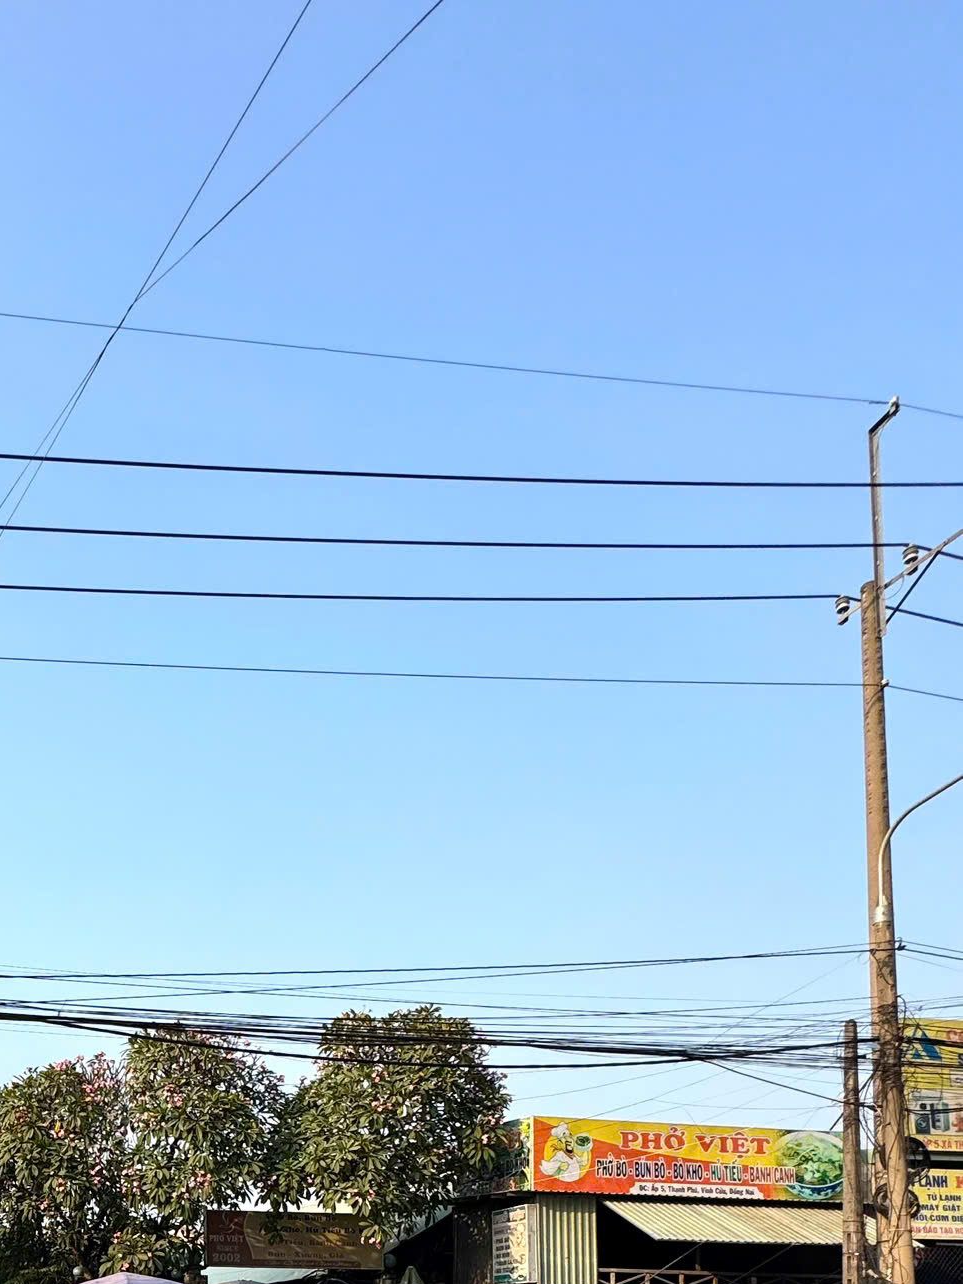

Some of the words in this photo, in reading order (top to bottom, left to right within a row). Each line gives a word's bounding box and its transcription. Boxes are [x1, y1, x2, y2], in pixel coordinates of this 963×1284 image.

[620, 1127, 686, 1151] PHỞ
[695, 1132, 771, 1158] VIỆT
[597, 1153, 614, 1177] PHỞ
[616, 1156, 628, 1178] BÒ
[634, 1156, 651, 1179] BÚN
[654, 1157, 666, 1179] BÒ
[673, 1158, 684, 1180] BÒ
[686, 1163, 703, 1181] KHO
[710, 1159, 722, 1182] HỦ
[724, 1160, 743, 1182] TIẾU
[749, 1163, 771, 1183] BÁNH
[773, 1166, 796, 1184] CANH
[212, 1253, 241, 1262] 2002
